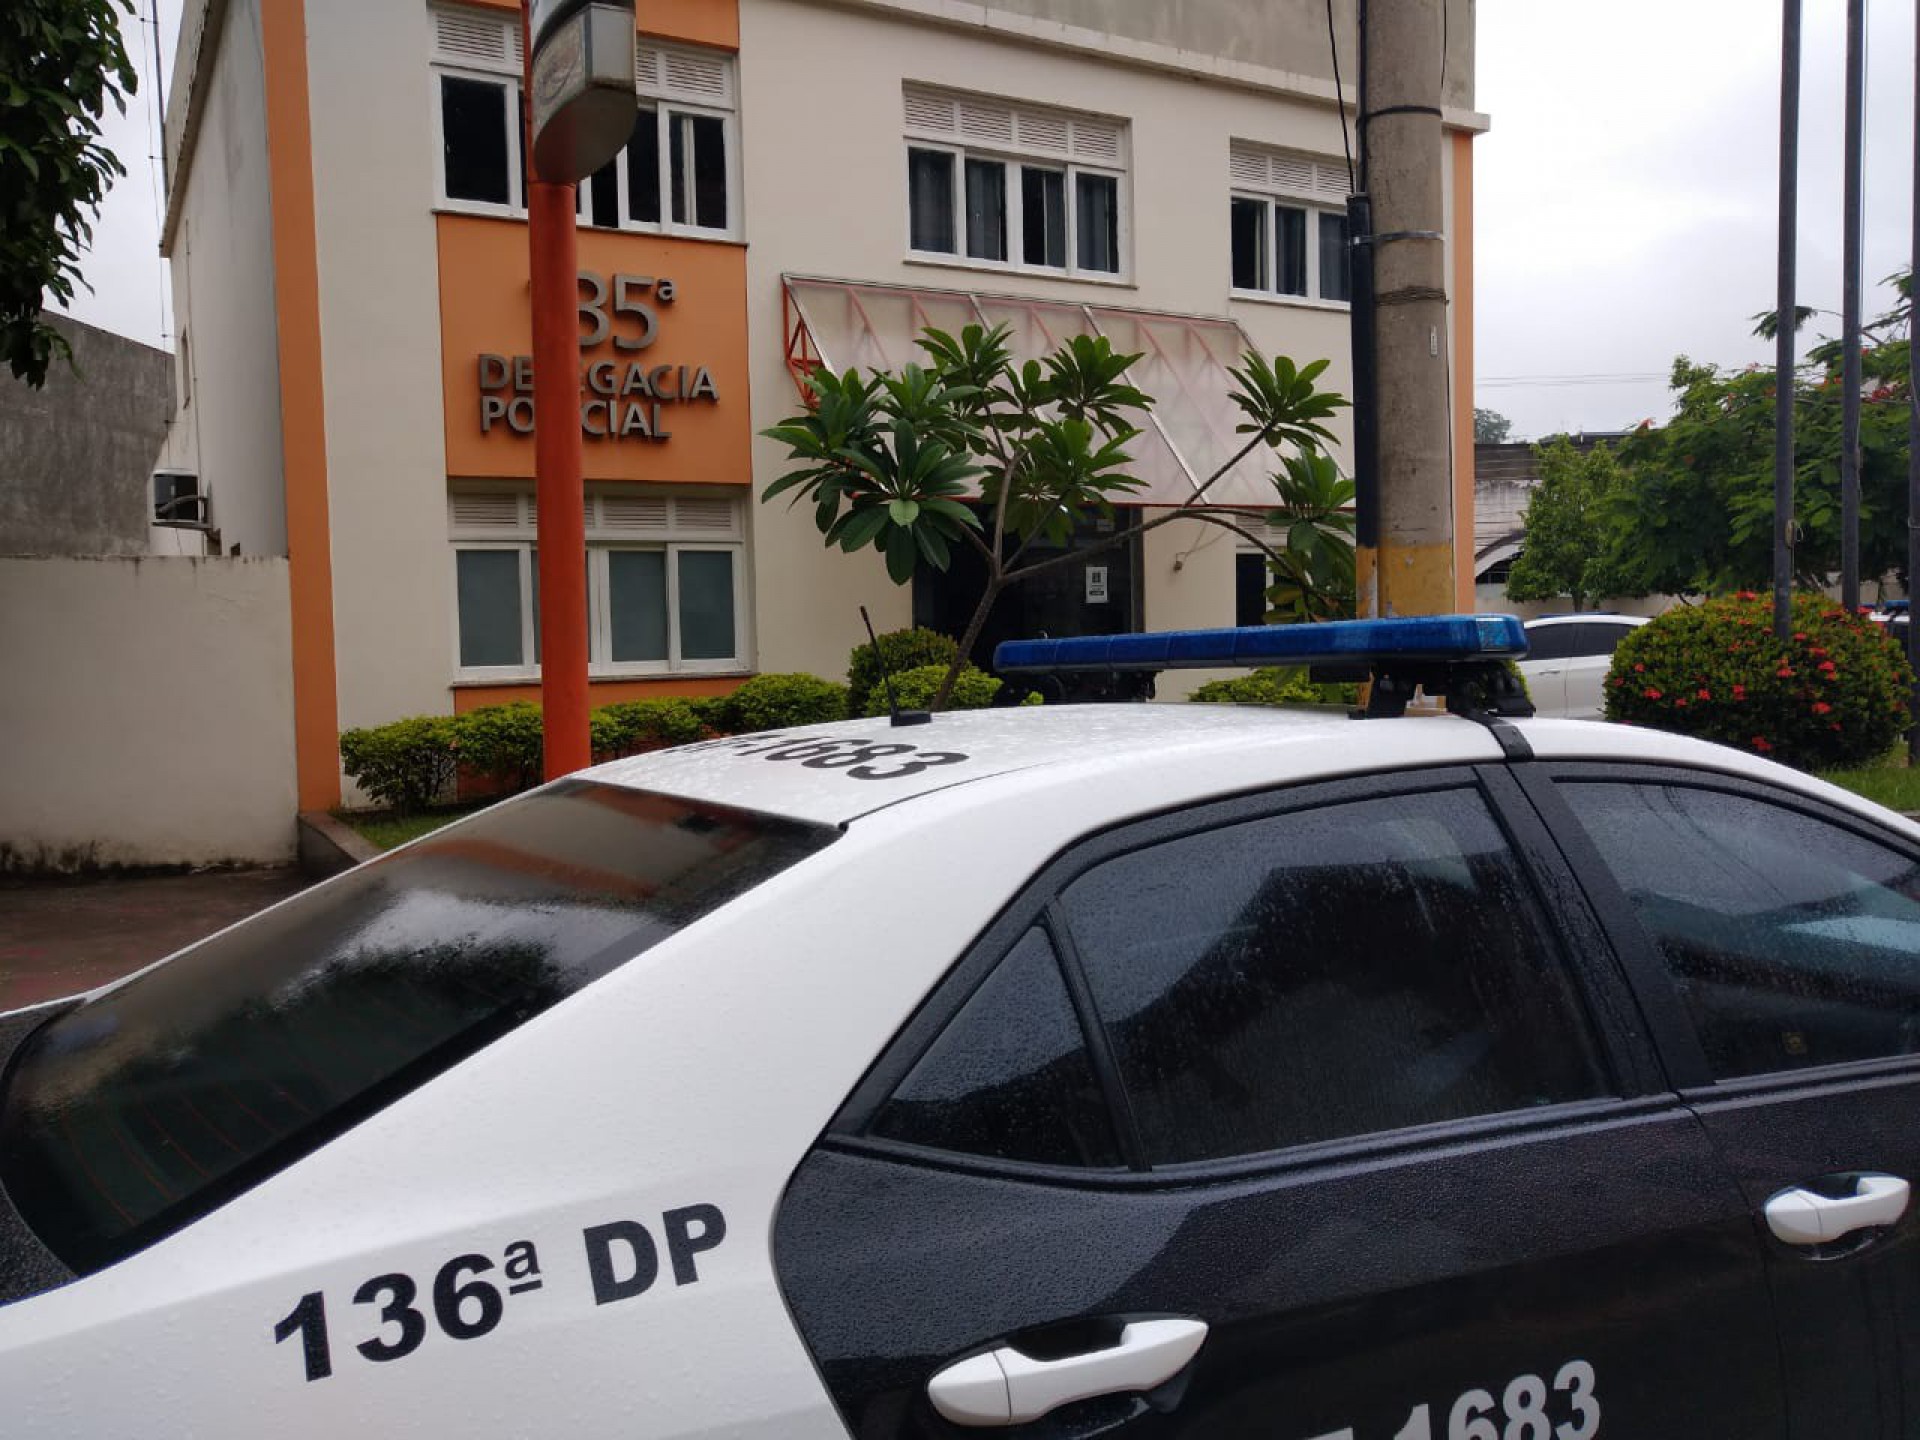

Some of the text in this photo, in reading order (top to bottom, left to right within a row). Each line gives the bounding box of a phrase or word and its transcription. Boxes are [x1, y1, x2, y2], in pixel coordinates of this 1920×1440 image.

[527, 270, 676, 350] 35ª
[478, 353, 719, 400] DEGACIA
[480, 396, 672, 439] POCIAL
[274, 1203, 727, 1382] 136ª DP
